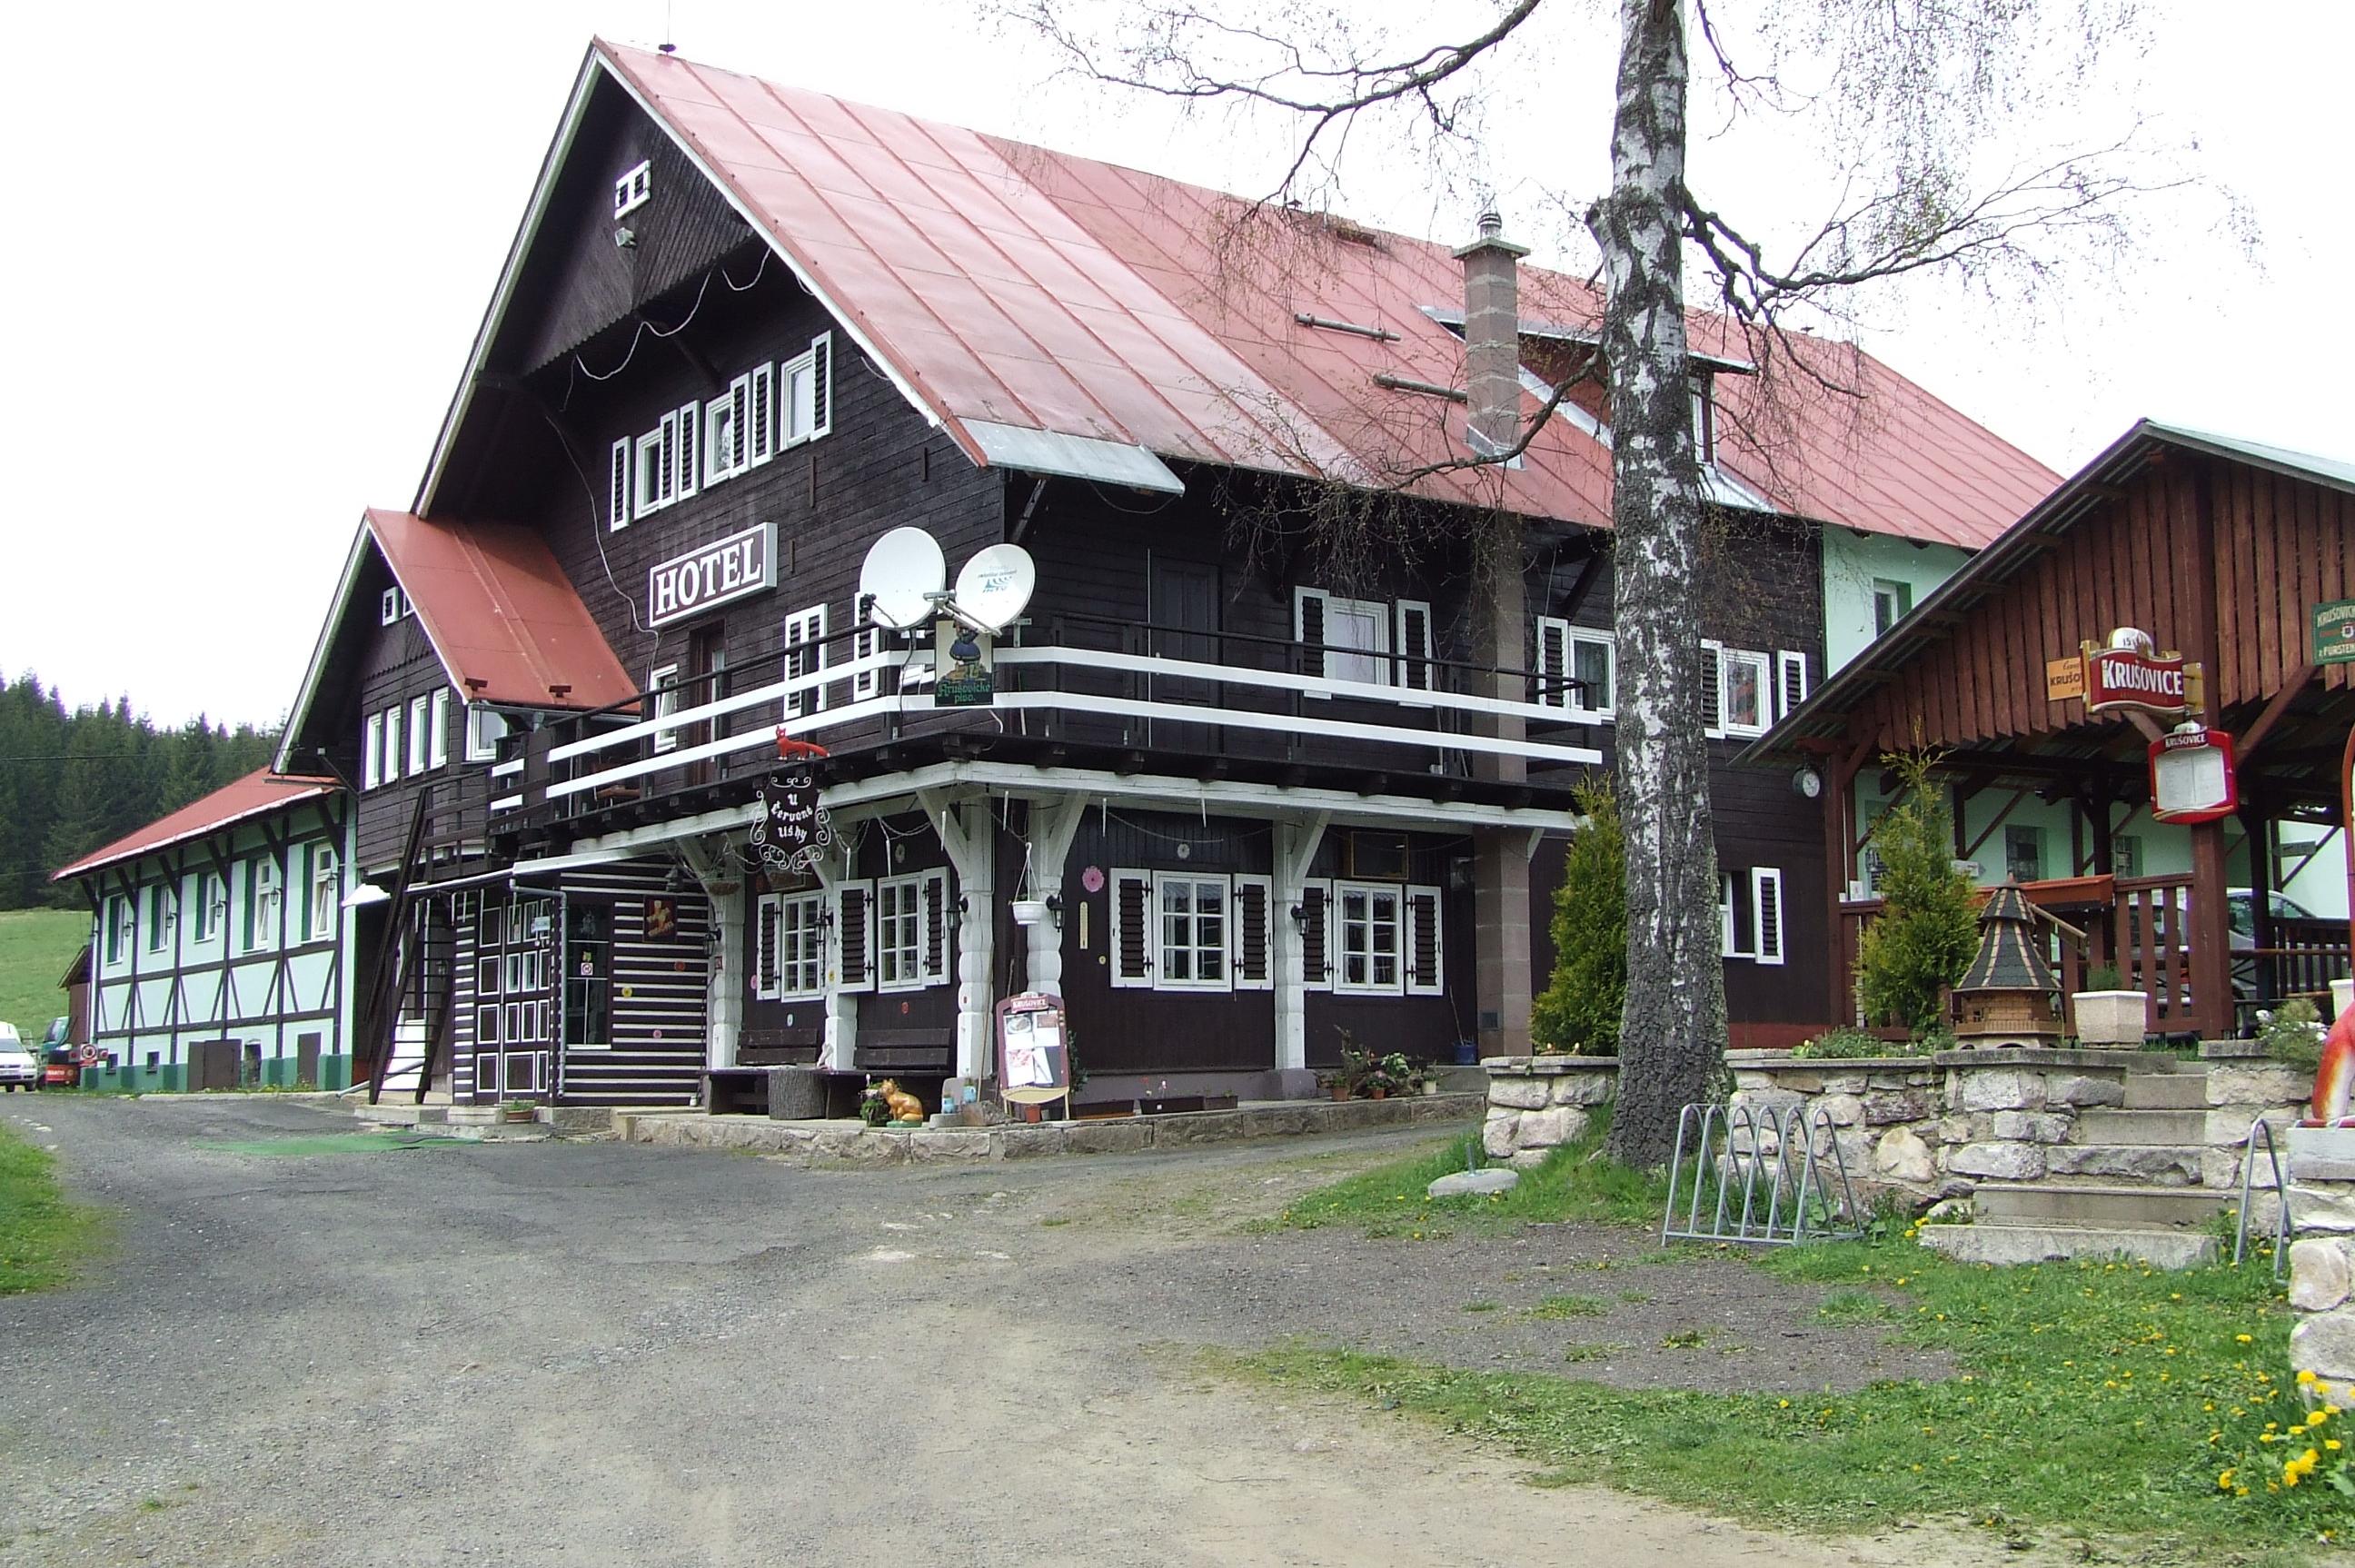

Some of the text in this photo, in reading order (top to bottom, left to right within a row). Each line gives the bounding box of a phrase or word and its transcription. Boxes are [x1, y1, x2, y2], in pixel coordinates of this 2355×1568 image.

[656, 538, 761, 616] HOTEL
[2050, 671, 2081, 687] KRUŠO
[2102, 658, 2183, 695] KRUŠOVICE
